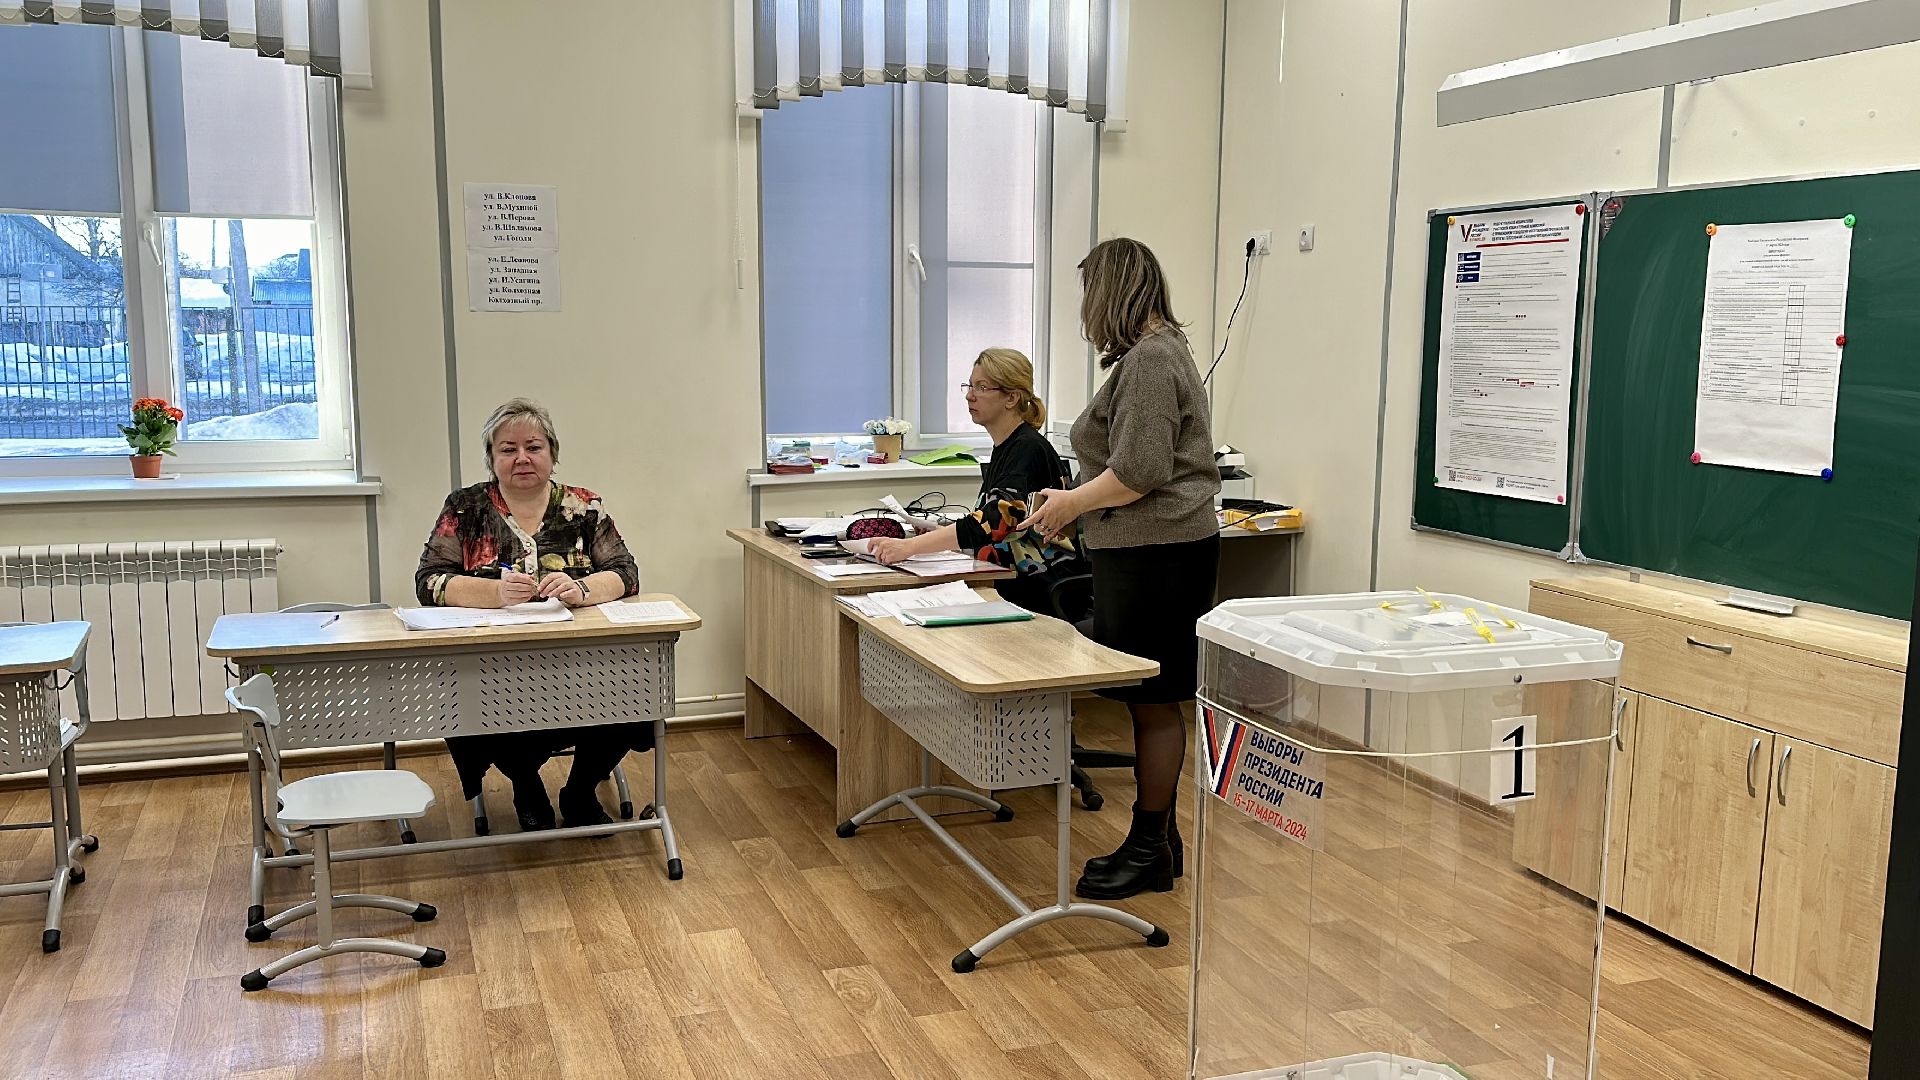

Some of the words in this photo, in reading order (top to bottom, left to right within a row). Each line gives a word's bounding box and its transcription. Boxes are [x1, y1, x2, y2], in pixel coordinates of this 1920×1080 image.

[1250, 730, 1305, 766] ВЫБОРЫ
[1501, 725, 1535, 800] 1
[1237, 772, 1285, 807] РОССИИ
[1243, 751, 1324, 799] ПРЕЗИДЕНТА
[1255, 804, 1283, 830] МАРТА
[1283, 818, 1308, 840] 2024
